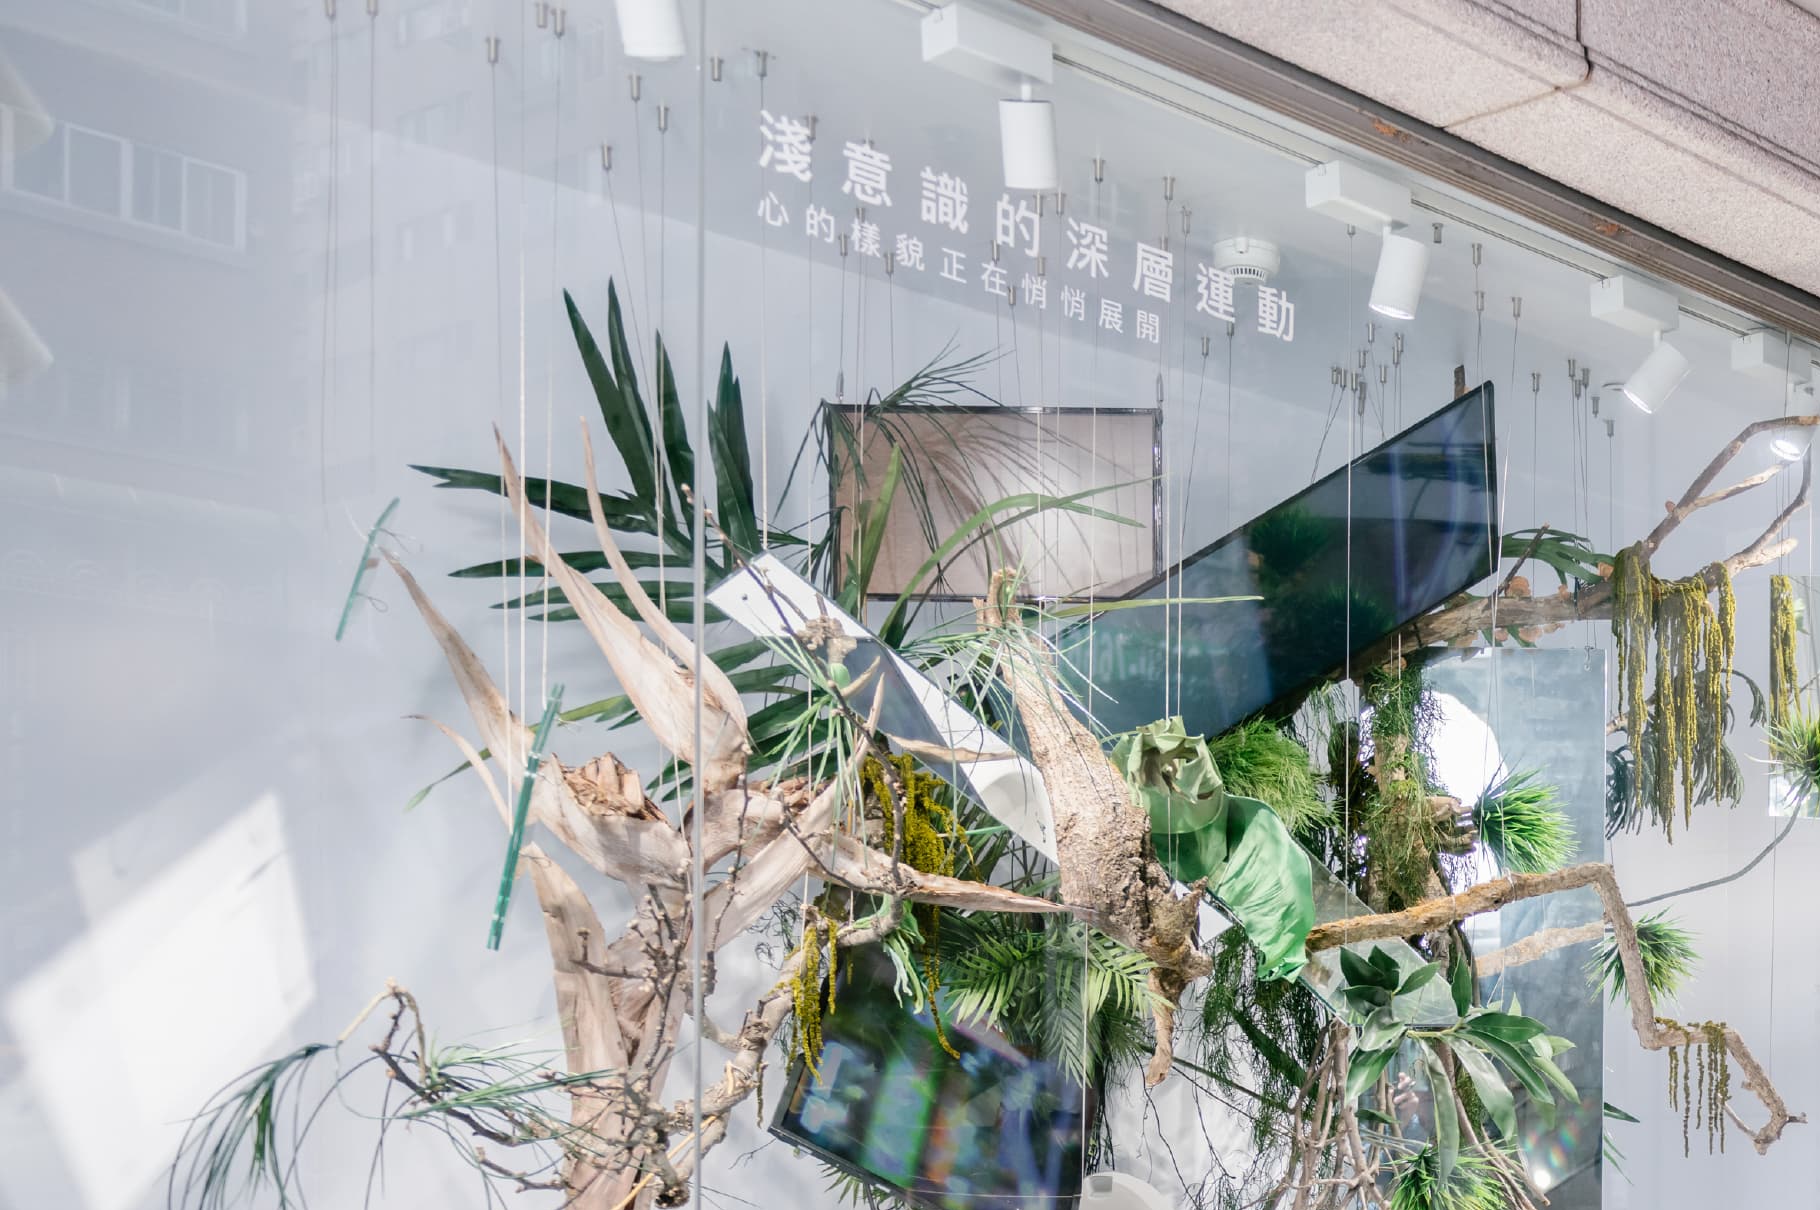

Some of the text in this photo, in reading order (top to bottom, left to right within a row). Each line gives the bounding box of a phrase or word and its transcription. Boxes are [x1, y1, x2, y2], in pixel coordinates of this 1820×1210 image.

[757, 108, 1296, 343] 淺意識的深層運動
[757, 191, 1161, 345] 心的樣貌正在悄悄展開
